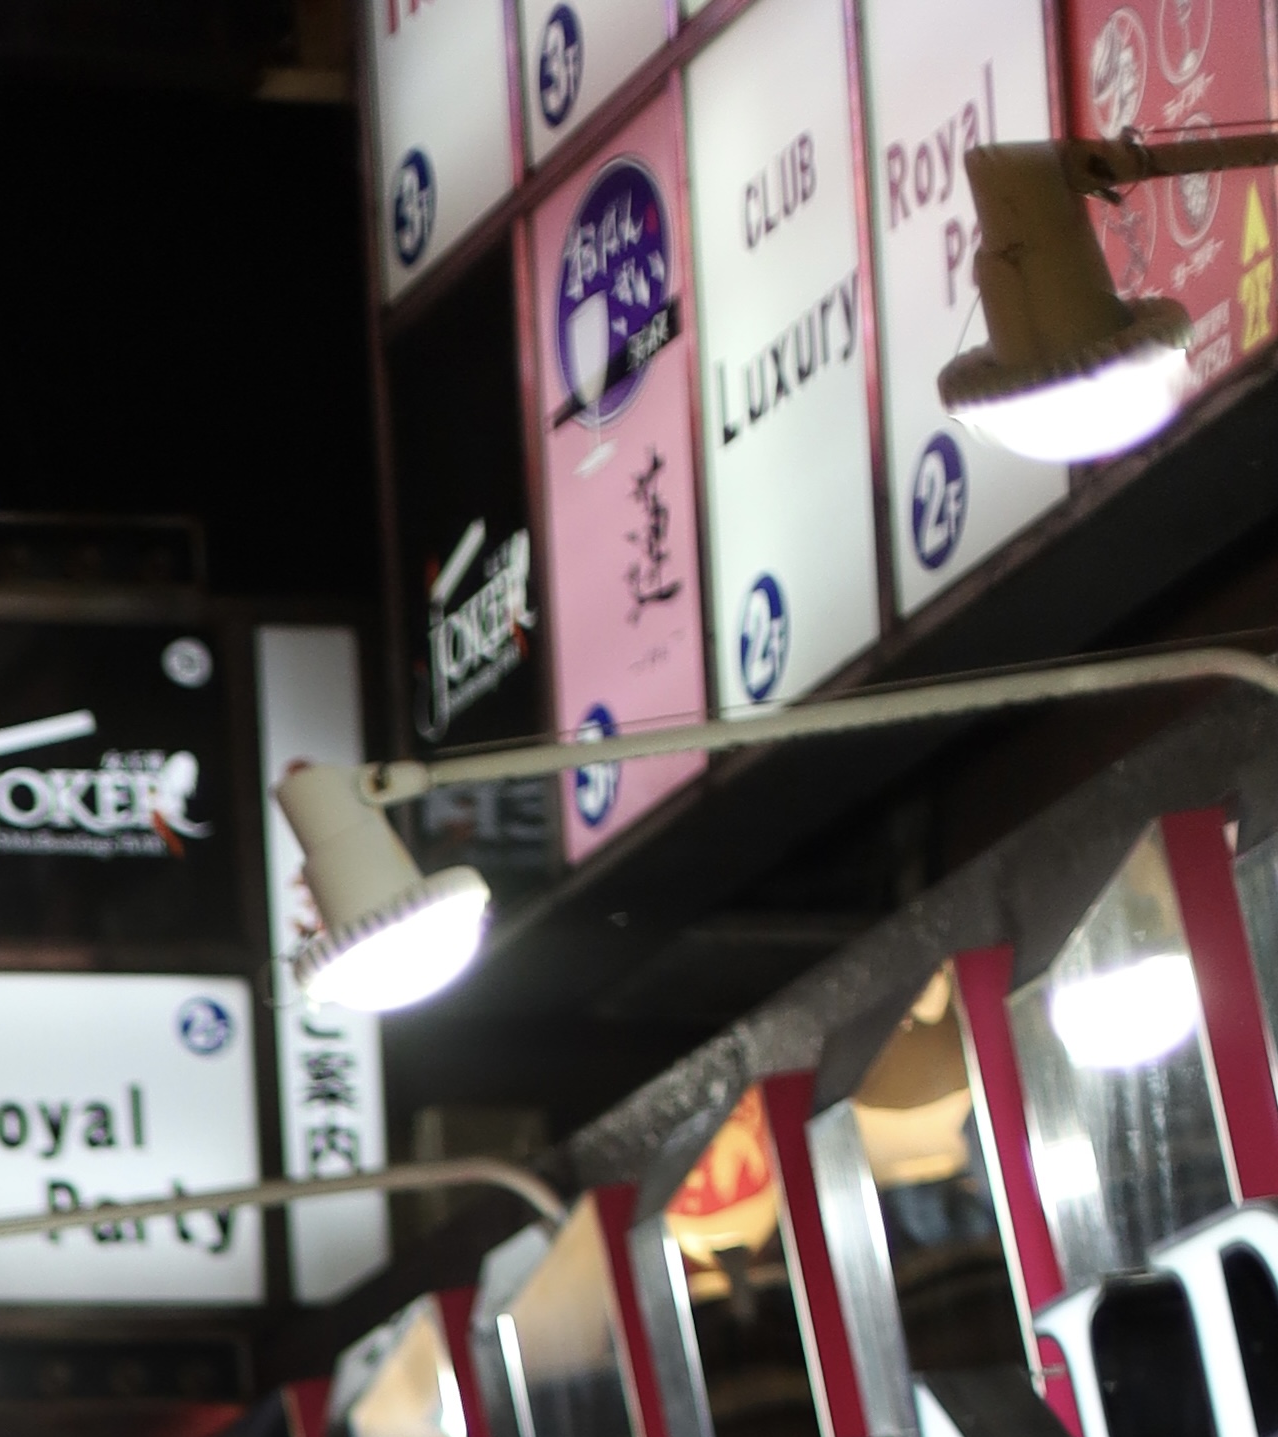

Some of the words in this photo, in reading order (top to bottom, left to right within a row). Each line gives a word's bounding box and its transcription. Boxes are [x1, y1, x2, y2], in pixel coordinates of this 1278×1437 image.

[742, 130, 816, 250] CLUB
[887, 62, 996, 230] Royal
[713, 264, 858, 447] Luxury
